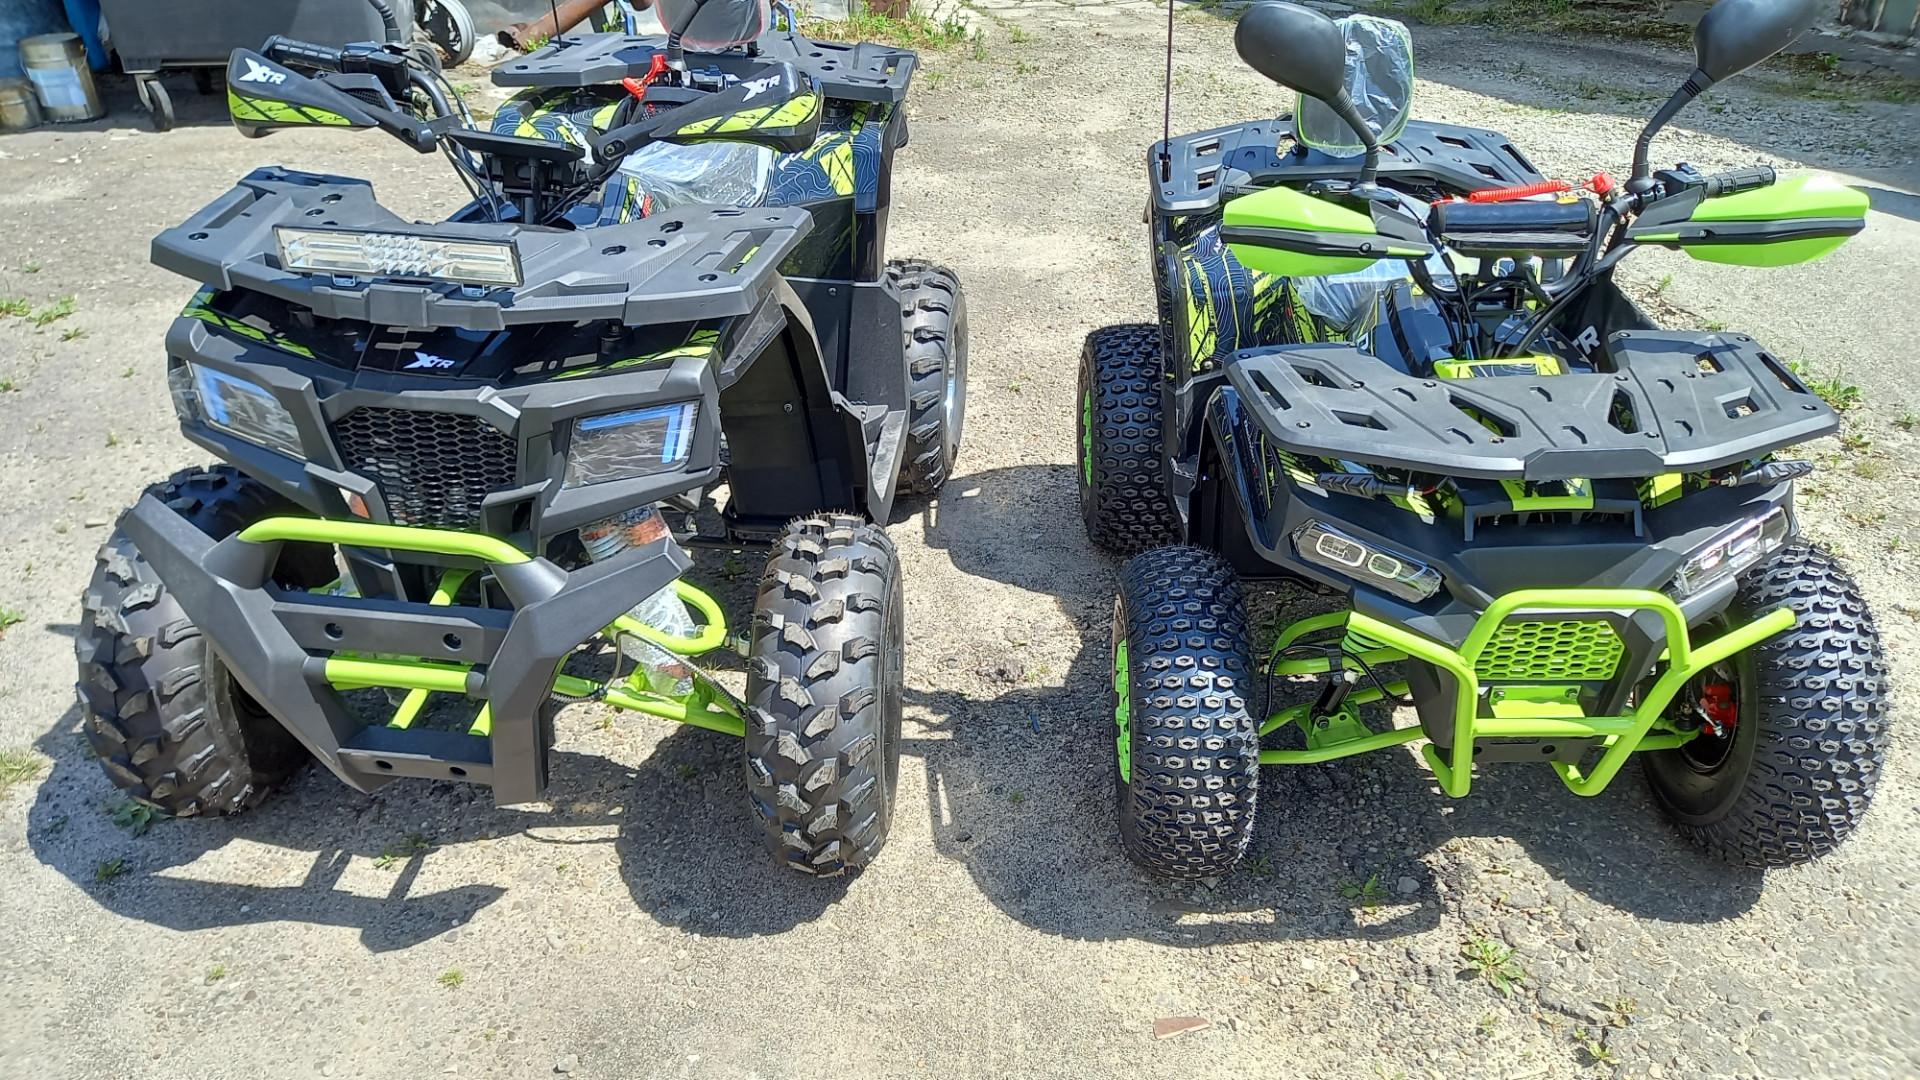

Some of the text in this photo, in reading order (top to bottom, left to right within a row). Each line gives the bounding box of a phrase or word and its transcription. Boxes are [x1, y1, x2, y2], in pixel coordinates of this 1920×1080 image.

[238, 57, 287, 85] XTR
[740, 74, 781, 103] XTR
[403, 351, 456, 369] XTR
